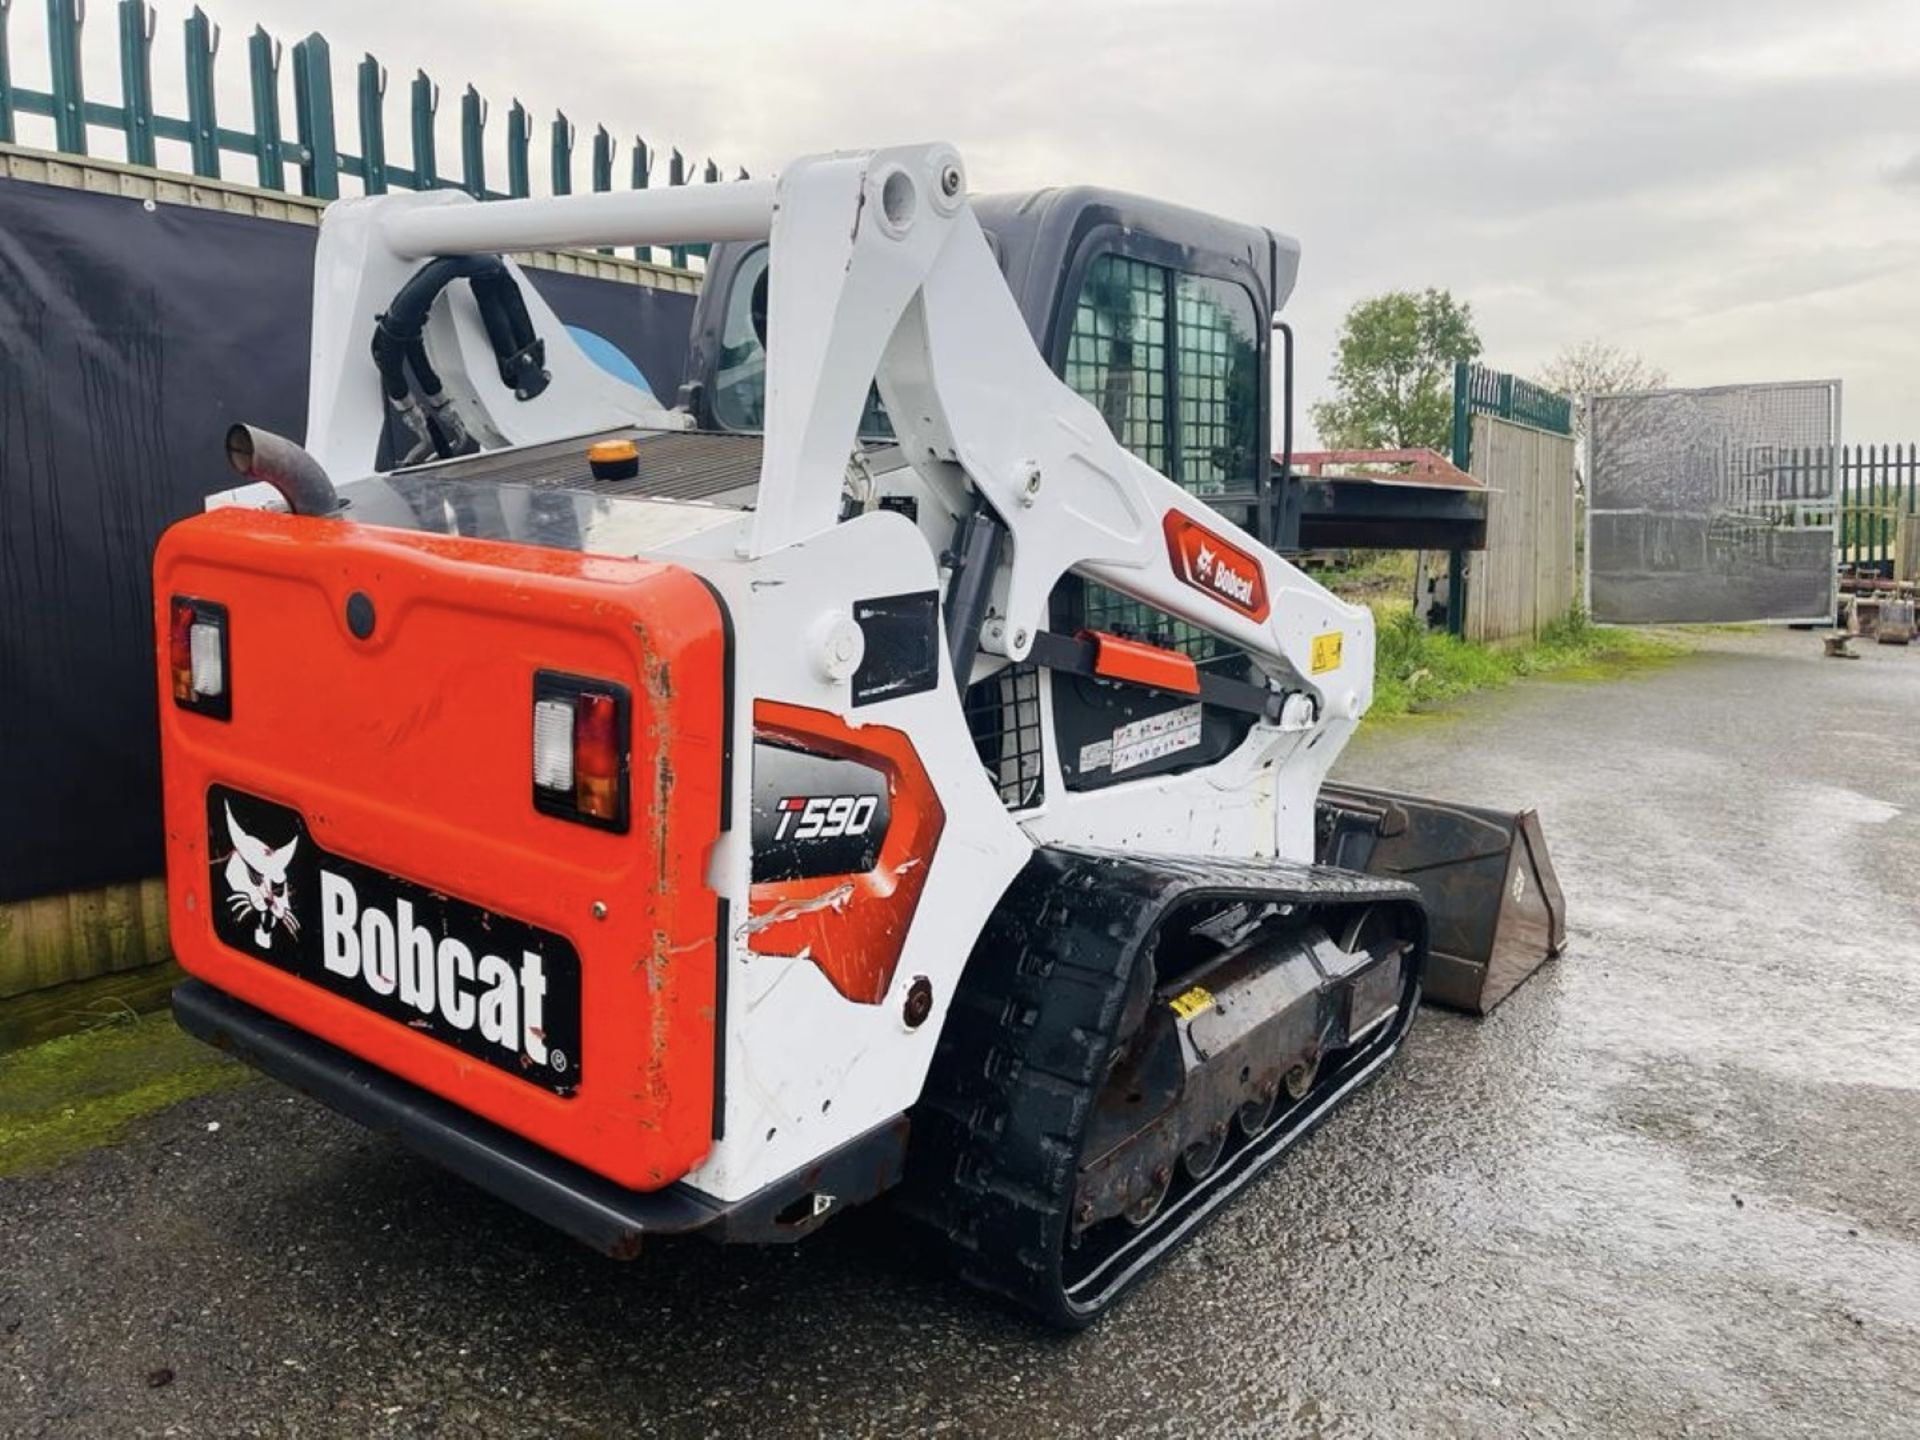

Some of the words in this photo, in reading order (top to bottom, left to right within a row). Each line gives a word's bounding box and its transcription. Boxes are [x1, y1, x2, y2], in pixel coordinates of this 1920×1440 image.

[1214, 559, 1253, 605] Bobcat
[774, 797, 879, 840] T590
[320, 869, 547, 1065] Bobcat
